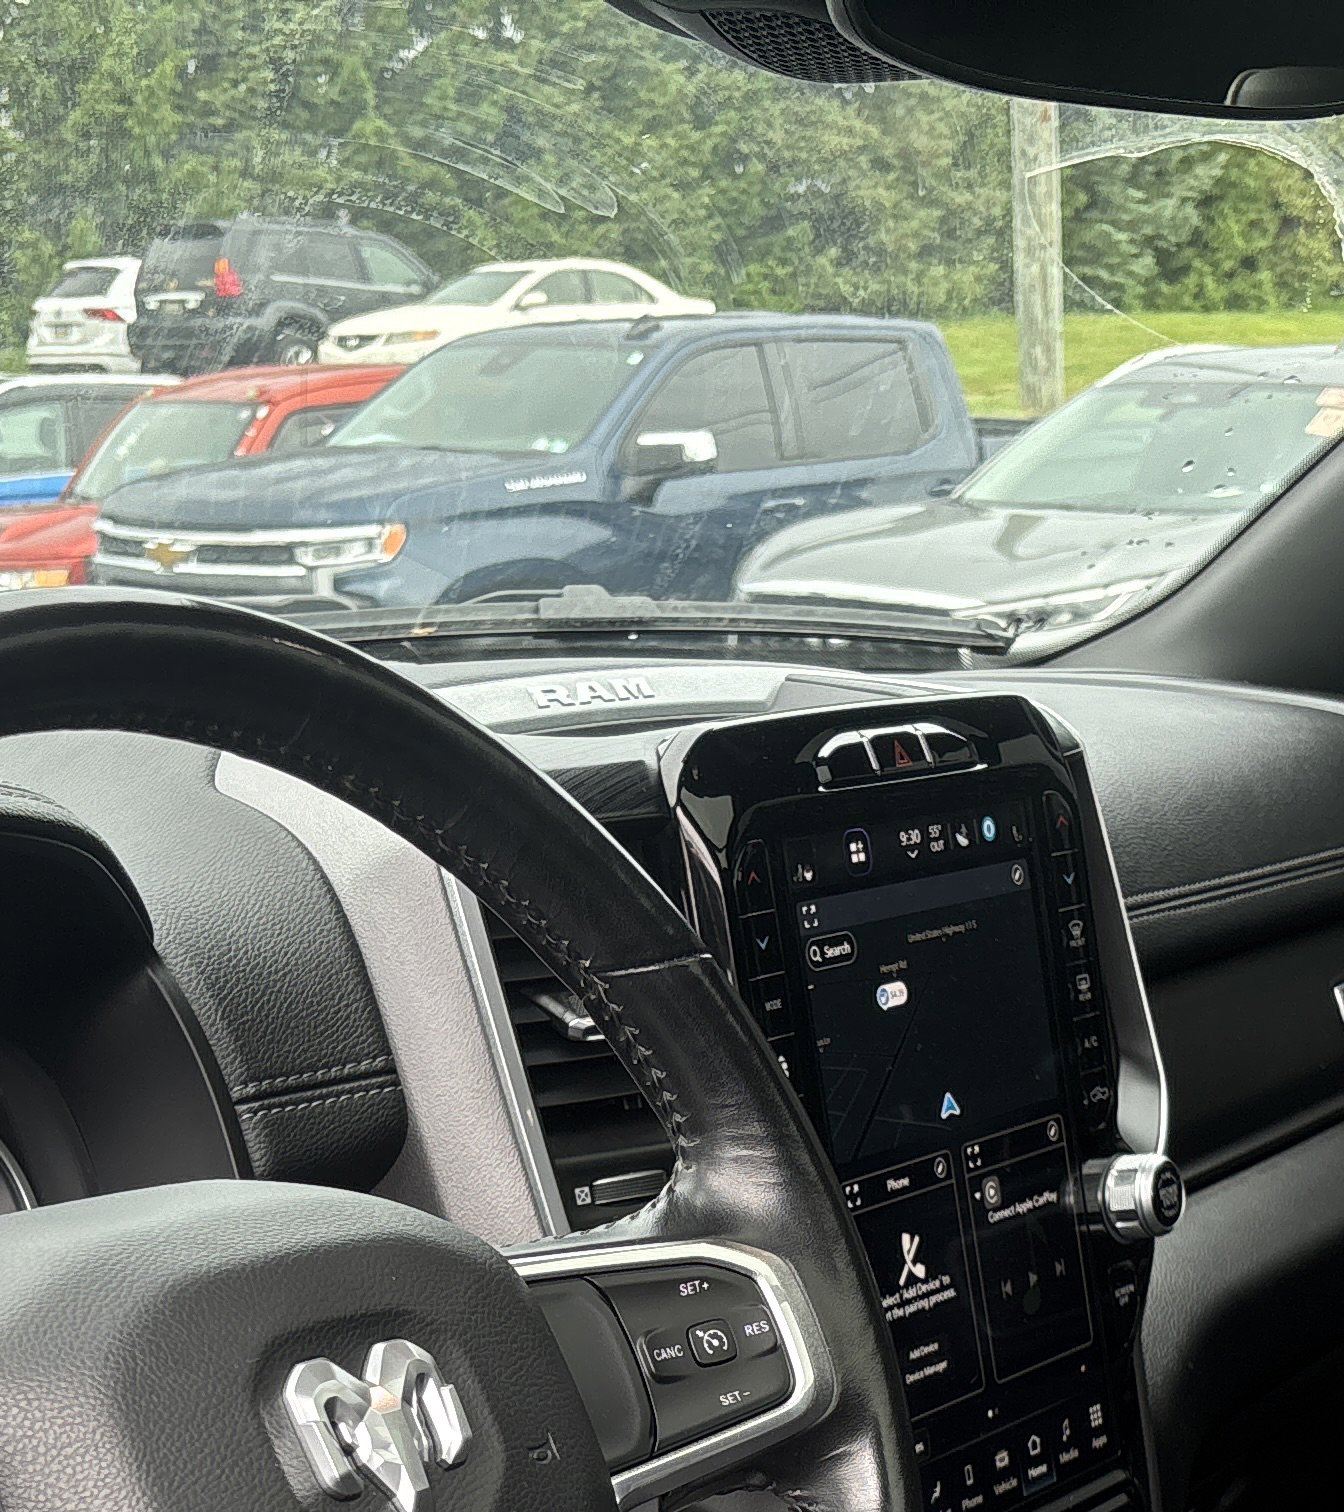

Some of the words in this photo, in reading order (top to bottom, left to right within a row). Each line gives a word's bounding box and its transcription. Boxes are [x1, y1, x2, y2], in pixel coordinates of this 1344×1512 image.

[527, 676, 655, 709] RAM
[898, 829, 921, 847] 9:30
[823, 941, 851, 959] Search
[886, 1177, 910, 1193] Phone
[744, 1320, 770, 1338] RES
[653, 1344, 684, 1361] CANC
[1027, 1463, 1048, 1480] Home
[993, 1476, 1018, 1496] Vehicle
[961, 1494, 984, 1512] Phone
